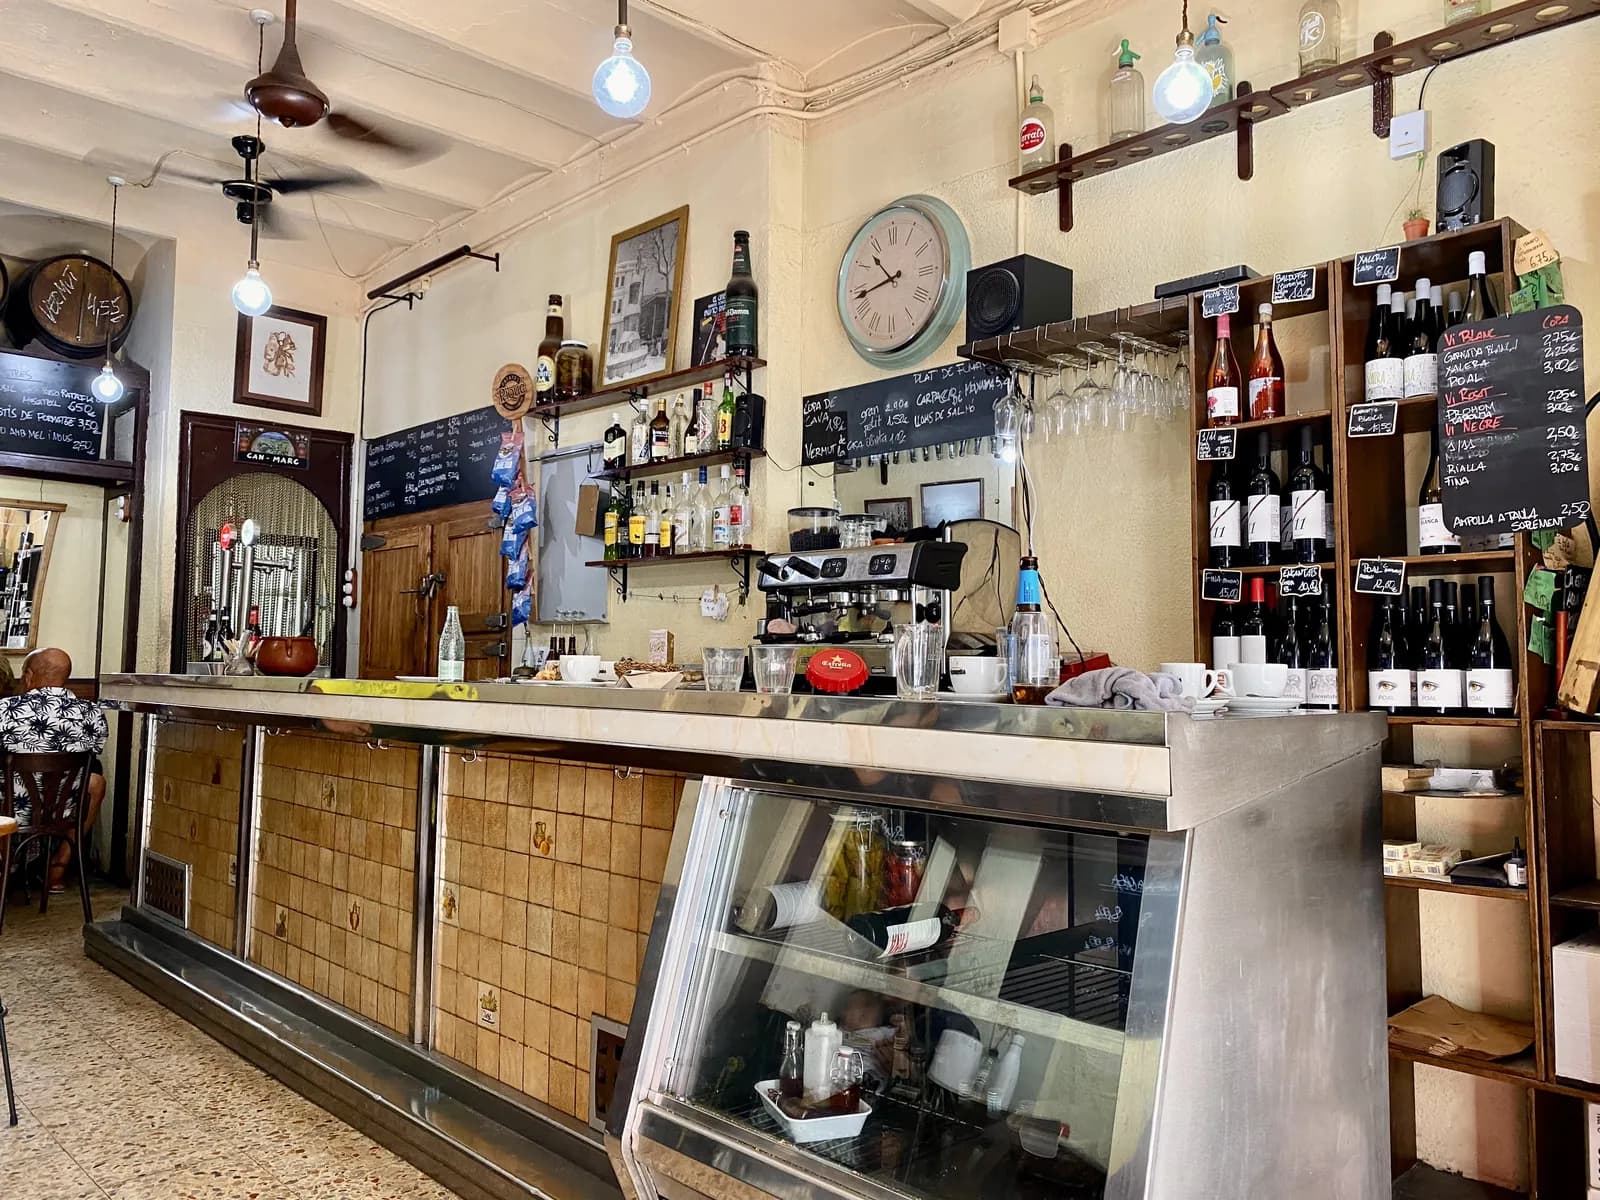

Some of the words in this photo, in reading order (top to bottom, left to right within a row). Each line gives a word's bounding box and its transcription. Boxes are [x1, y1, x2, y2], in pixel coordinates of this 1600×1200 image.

[1447, 373, 1483, 388] POAL
[1463, 415, 1505, 433] NEGRE
[1453, 513, 1494, 529] AMPOLLA
